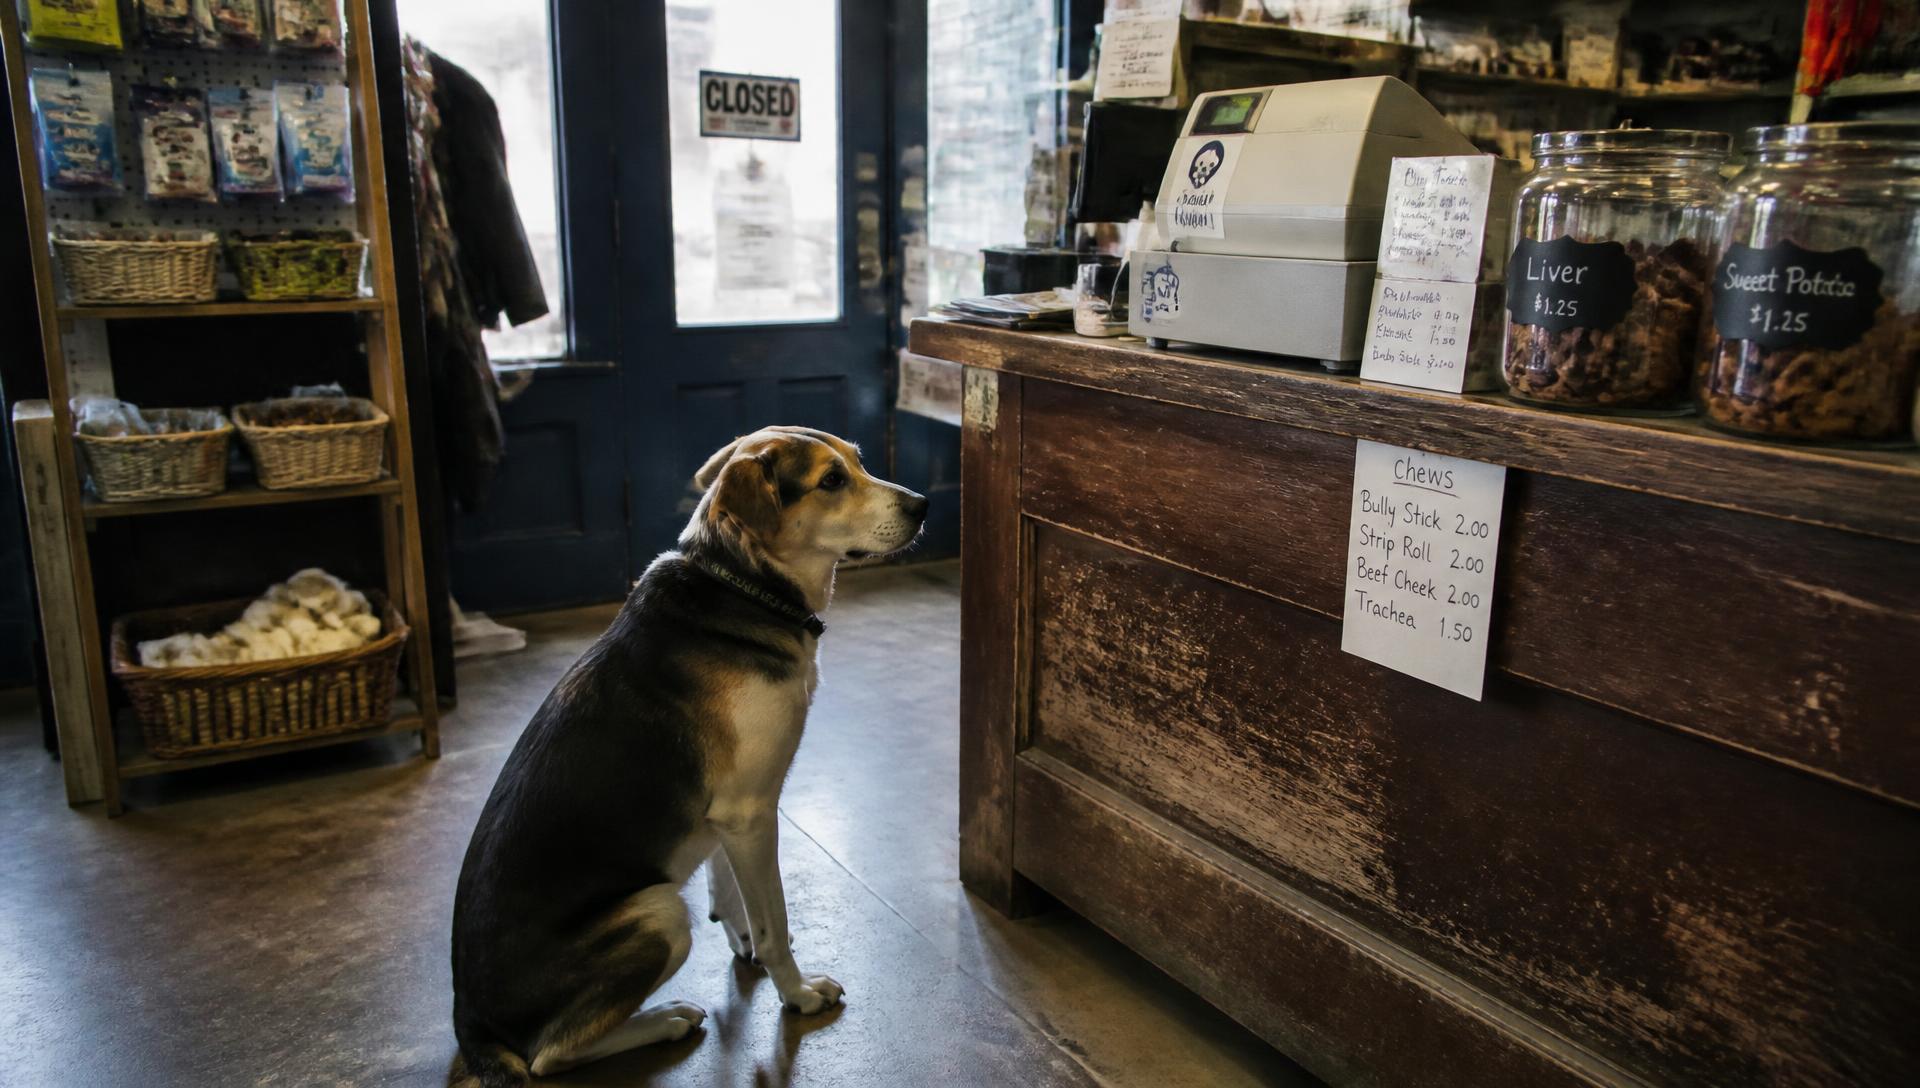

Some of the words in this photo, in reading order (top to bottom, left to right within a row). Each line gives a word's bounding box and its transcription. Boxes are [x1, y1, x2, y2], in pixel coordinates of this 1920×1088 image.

[706, 79, 795, 117] CLOSED
[1527, 256, 1588, 284] Liver
[1534, 292, 1578, 316] $1.25
[1394, 456, 1454, 489] Chews
[1360, 489, 1396, 528] Bully
[1403, 502, 1442, 531] Stick
[1455, 514, 1489, 539] 2.00
[1360, 524, 1395, 560] Strip
[1403, 535, 1431, 563] Roll
[1450, 549, 1484, 574] 2.00
[1357, 556, 1388, 585] Beef
[1394, 570, 1437, 601] Cheek
[1447, 584, 1480, 609] 2.00
[1354, 589, 1417, 630] Trachea
[1440, 617, 1473, 642] 1.50
